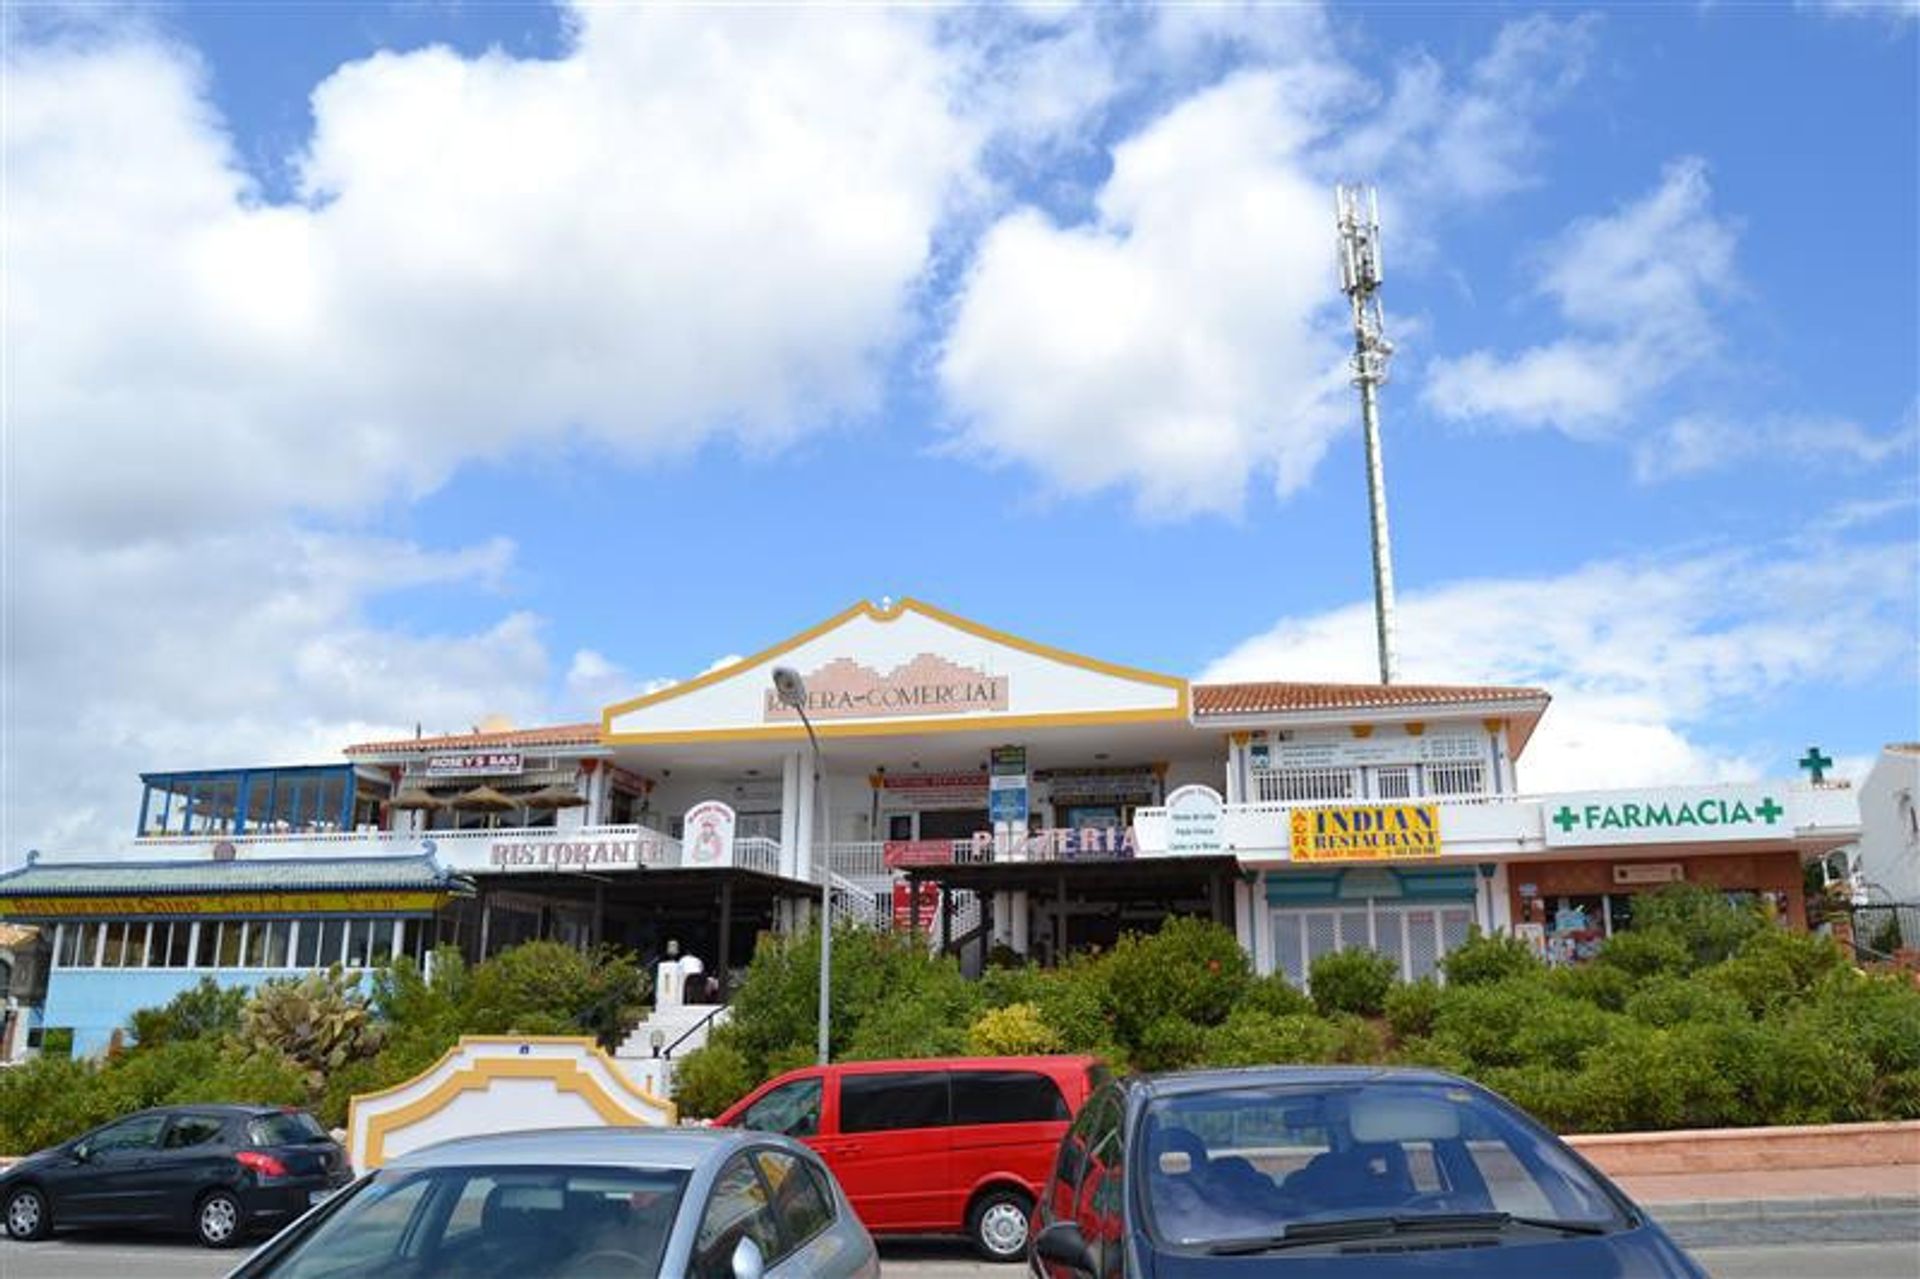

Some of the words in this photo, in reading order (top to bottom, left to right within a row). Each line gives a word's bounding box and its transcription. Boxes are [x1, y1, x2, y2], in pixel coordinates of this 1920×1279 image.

[489, 755, 518, 767] BAR
[1315, 808, 1437, 834] INDIAN
[1584, 799, 1753, 829] FARMACIA
[1314, 831, 1437, 850] RESTAURANT
